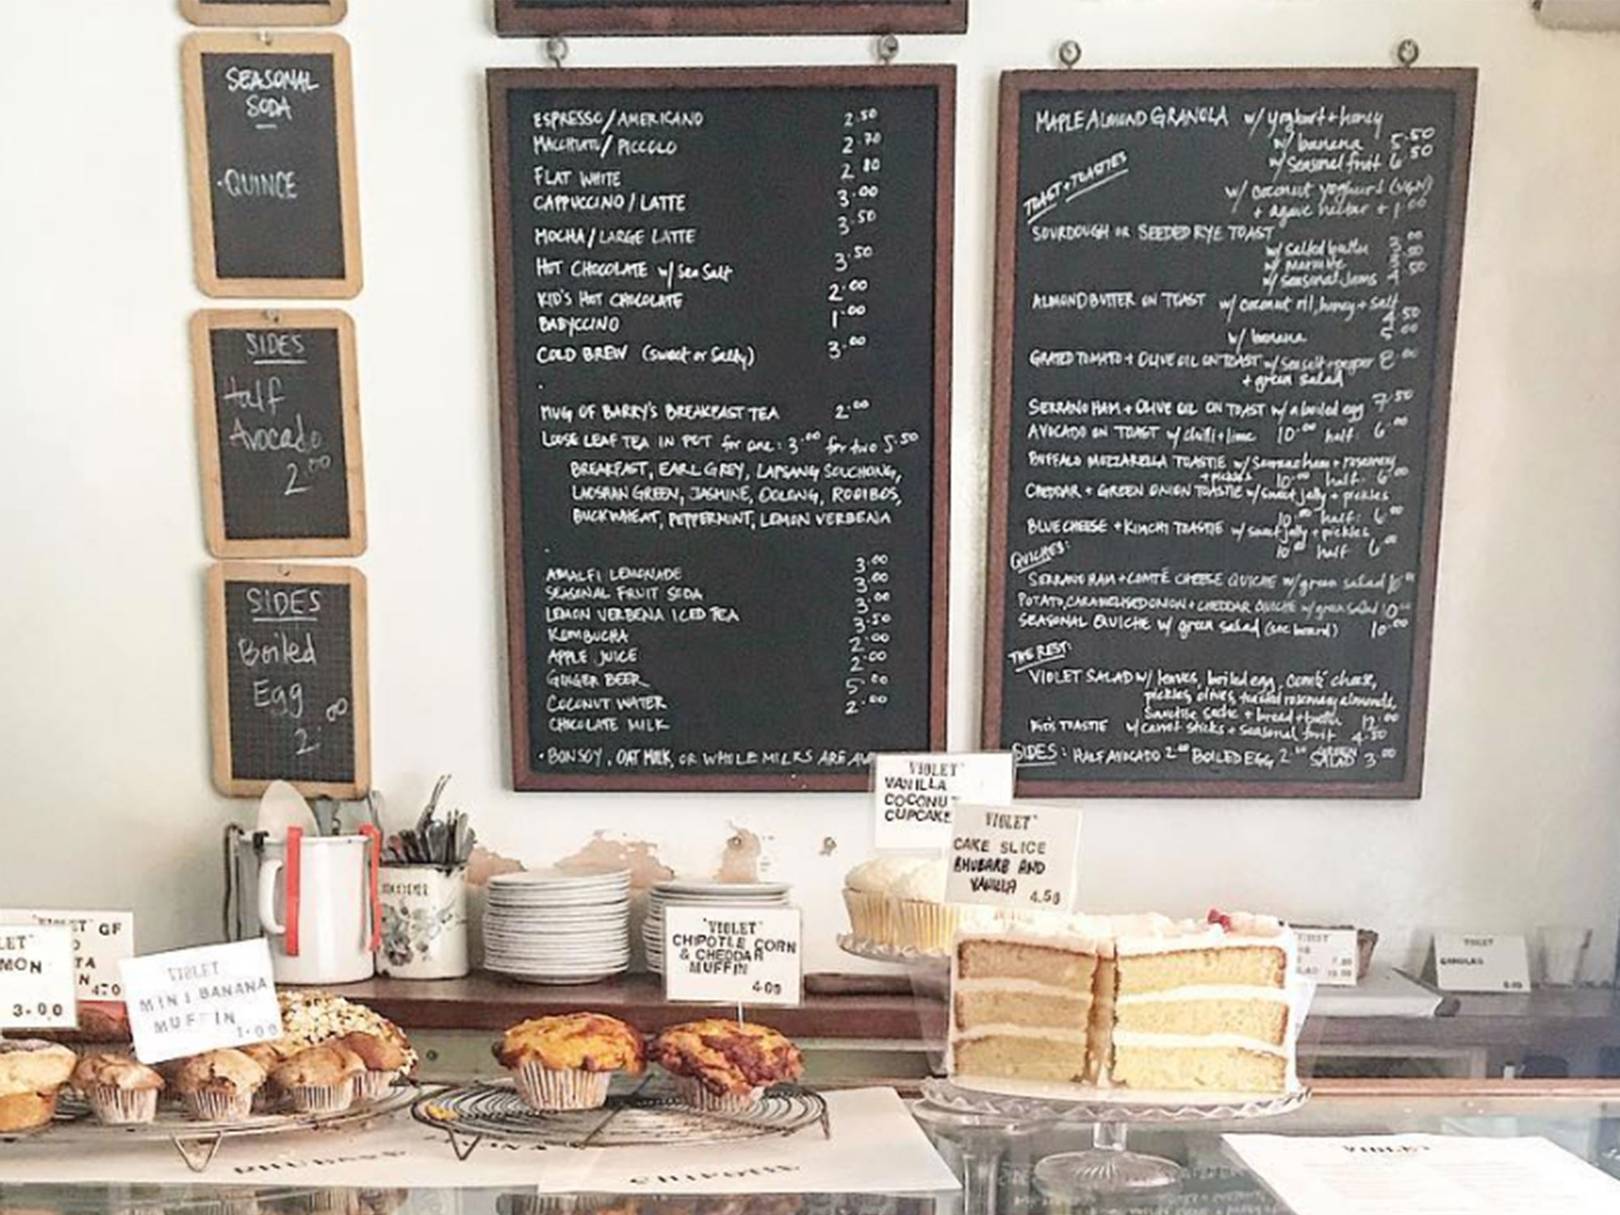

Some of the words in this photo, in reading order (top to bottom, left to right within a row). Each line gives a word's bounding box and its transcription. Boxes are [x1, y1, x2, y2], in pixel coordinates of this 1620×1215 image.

[226, 66, 319, 92] SEASONAL
[246, 95, 292, 119] SODA
[1036, 110, 1085, 132] MAPLE
[1150, 106, 1229, 127] GRANOLA
[224, 169, 298, 199] QUINCE
[534, 167, 572, 185] FLAT
[580, 171, 621, 187] WHITE
[652, 229, 696, 244] LATTE
[1032, 224, 1109, 241] SOURDOUGH
[1138, 224, 1191, 240] SEEDED
[1194, 226, 1223, 244] RYE
[1228, 225, 1275, 241] TOAST
[536, 258, 563, 276] HOT
[571, 261, 648, 277] CHOCOLATE
[579, 292, 602, 305] HOT
[610, 293, 683, 309] CHOCOLATE
[1161, 293, 1206, 307] TOAST
[538, 316, 620, 337] BABYCCINO
[246, 333, 304, 356] SIDES
[537, 347, 576, 363] COLD
[583, 346, 628, 362] BREW
[1138, 352, 1174, 367] OLIVE
[540, 405, 572, 422] MUG
[579, 404, 596, 419] OF
[665, 403, 744, 421] BREAKFAST
[750, 406, 780, 421] TEA
[1092, 401, 1121, 415] HAM
[1227, 403, 1266, 418] TOAST
[1028, 424, 1086, 439] AVOCADO
[1114, 426, 1160, 439] TOAST
[584, 432, 617, 447] LEAF
[623, 436, 649, 450] TEA
[659, 436, 674, 447] IN
[682, 435, 712, 448] POT
[1028, 451, 1081, 467] BUFFALO
[659, 462, 701, 476] EARL
[760, 512, 810, 527] LEMON
[816, 511, 891, 524] VERBENA
[1027, 518, 1061, 535] BLUE
[1063, 519, 1108, 533] CHEESE
[247, 588, 320, 615] SIDES
[546, 586, 610, 599] SEASONAL
[617, 586, 659, 600] FRUIT
[667, 587, 703, 600] SODA
[546, 607, 590, 622] LEMON
[597, 608, 664, 622] VERBENA
[672, 607, 706, 622] ICED
[710, 606, 739, 622] TEA
[1018, 613, 1088, 628] SEASONAL
[1093, 615, 1150, 630] QUICHE
[548, 628, 628, 643] KOMBUCHA
[239, 633, 317, 666] Boiled
[548, 649, 587, 664] APPLE
[594, 648, 638, 665] JUICE
[547, 669, 598, 687] GINGER
[1029, 670, 1083, 684] VIOLET
[1086, 669, 1133, 684] SALAD
[254, 679, 303, 717] Egg
[546, 695, 611, 712] COCONUT
[617, 696, 667, 711] WATER
[549, 718, 618, 732] CHOCOLATE
[628, 718, 670, 732] MILK
[679, 753, 697, 765] OR
[703, 752, 759, 765] WHOLE
[762, 750, 813, 766] MILKS
[818, 750, 845, 765] ARE
[1106, 750, 1160, 763] AVOCADO
[1244, 751, 1274, 769] EGG
[884, 777, 947, 791] VANILLA
[884, 793, 961, 808] COCONU
[953, 838, 989, 853] CAKE
[1000, 841, 1046, 854] SLICE
[953, 856, 1010, 874] RHUBARB
[1018, 859, 1045, 874] AND
[971, 878, 1017, 894] VANILLA
[99, 924, 121, 936] GF
[672, 934, 746, 949] CHIPOTLE
[754, 939, 796, 953] CORN
[679, 949, 690, 960] &
[696, 948, 764, 961] CHEDDAR
[0, 959, 42, 974] MON
[689, 961, 748, 975] MUFFIN
[139, 995, 192, 1012] MINI
[199, 977, 268, 1000] BANANA
[13, 1004, 63, 1017] 3.00
